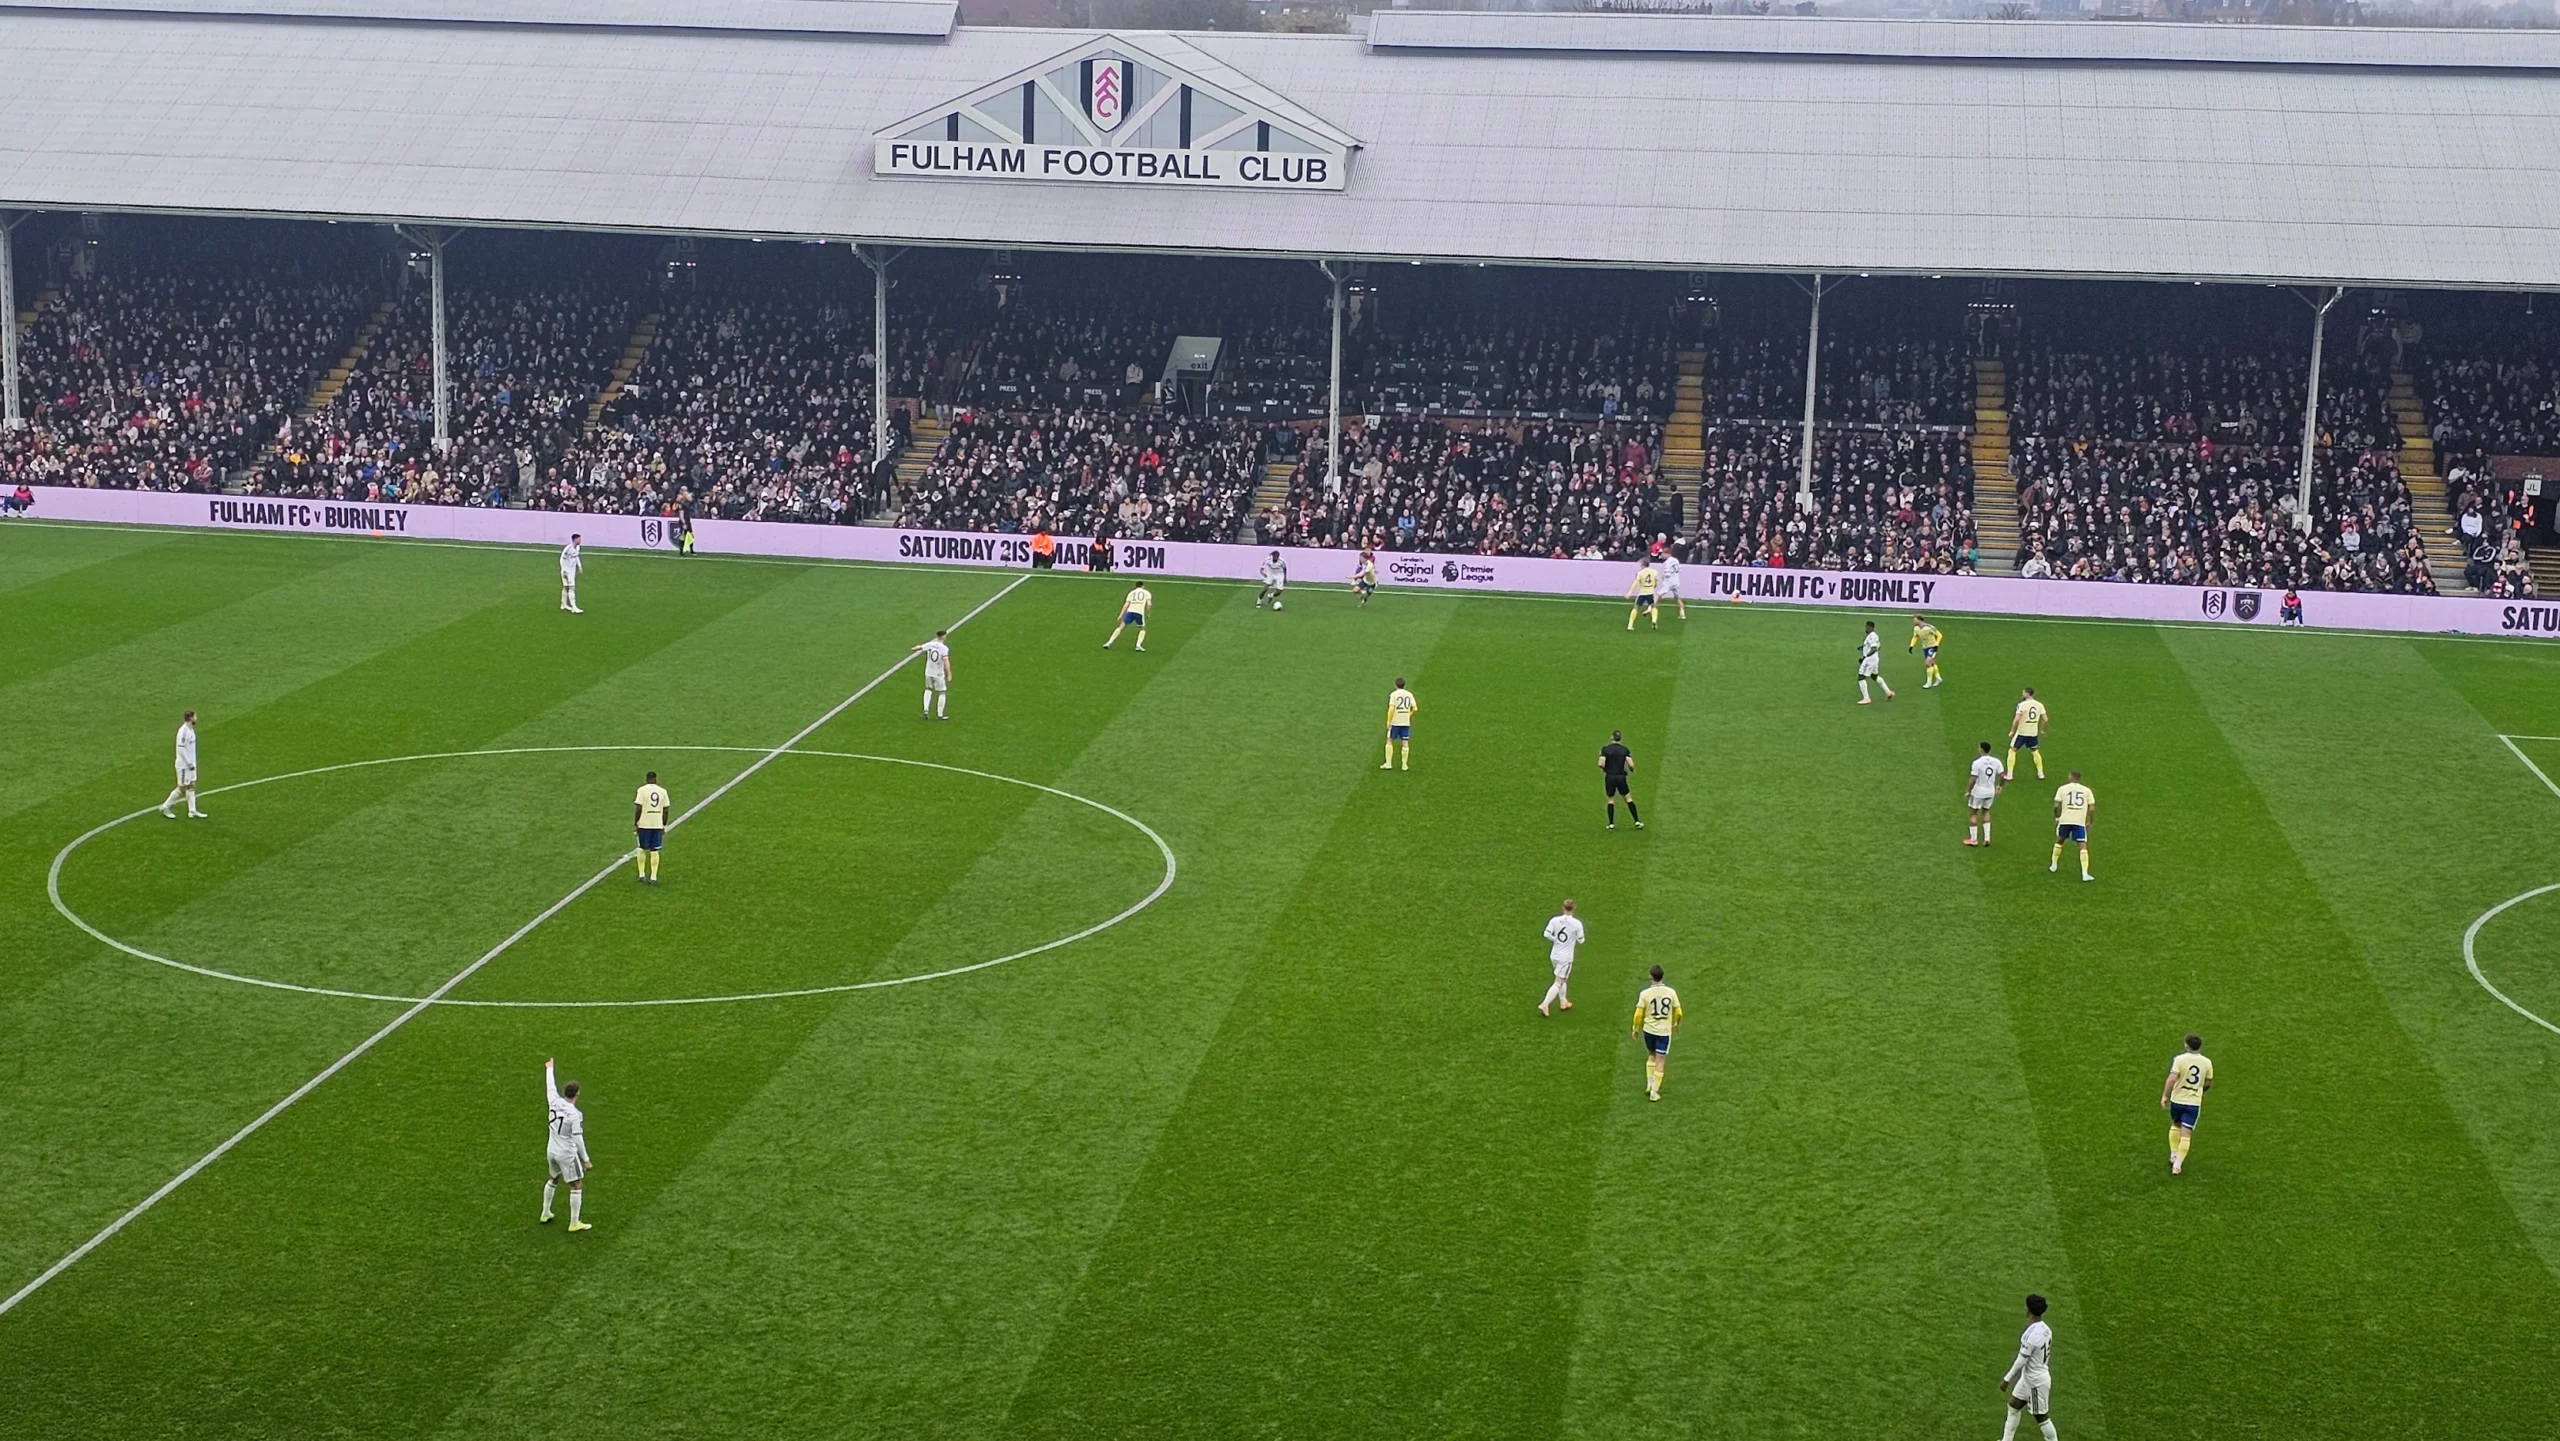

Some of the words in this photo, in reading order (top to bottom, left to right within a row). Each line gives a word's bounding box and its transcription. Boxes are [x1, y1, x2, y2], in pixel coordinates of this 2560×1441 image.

[891, 144, 1025, 173] FULHAM
[1043, 150, 1220, 180] FOOTBALL
[1239, 156, 1327, 183] CLUB
[1190, 362, 1208, 370] exit
[999, 384, 1017, 393] PRESS
[210, 501, 284, 525] FULHAM
[289, 505, 310, 527] FC
[325, 506, 407, 531] BURNLEY
[900, 535, 995, 561] SATURDAY
[1000, 540, 1033, 563] 21S
[1124, 546, 1165, 569] 3PM
[1390, 563, 1434, 577] Original
[1461, 564, 1494, 573] Premier
[1461, 574, 1494, 583] League
[1645, 574, 1652, 584] 4
[1710, 572, 1794, 598] FULHAM
[1799, 576, 1824, 598] FC
[1840, 578, 1935, 603] BURNLEY
[1132, 591, 1145, 602] 10
[926, 648, 939, 662] 10
[1396, 696, 1411, 710] 20
[2028, 707, 2037, 720] 6
[1985, 767, 1993, 779] 9
[650, 792, 659, 808] 9
[2066, 792, 2085, 807] 15
[1557, 926, 1568, 943] 6
[1650, 998, 1671, 1016] 18
[2186, 1065, 2200, 1085] 3
